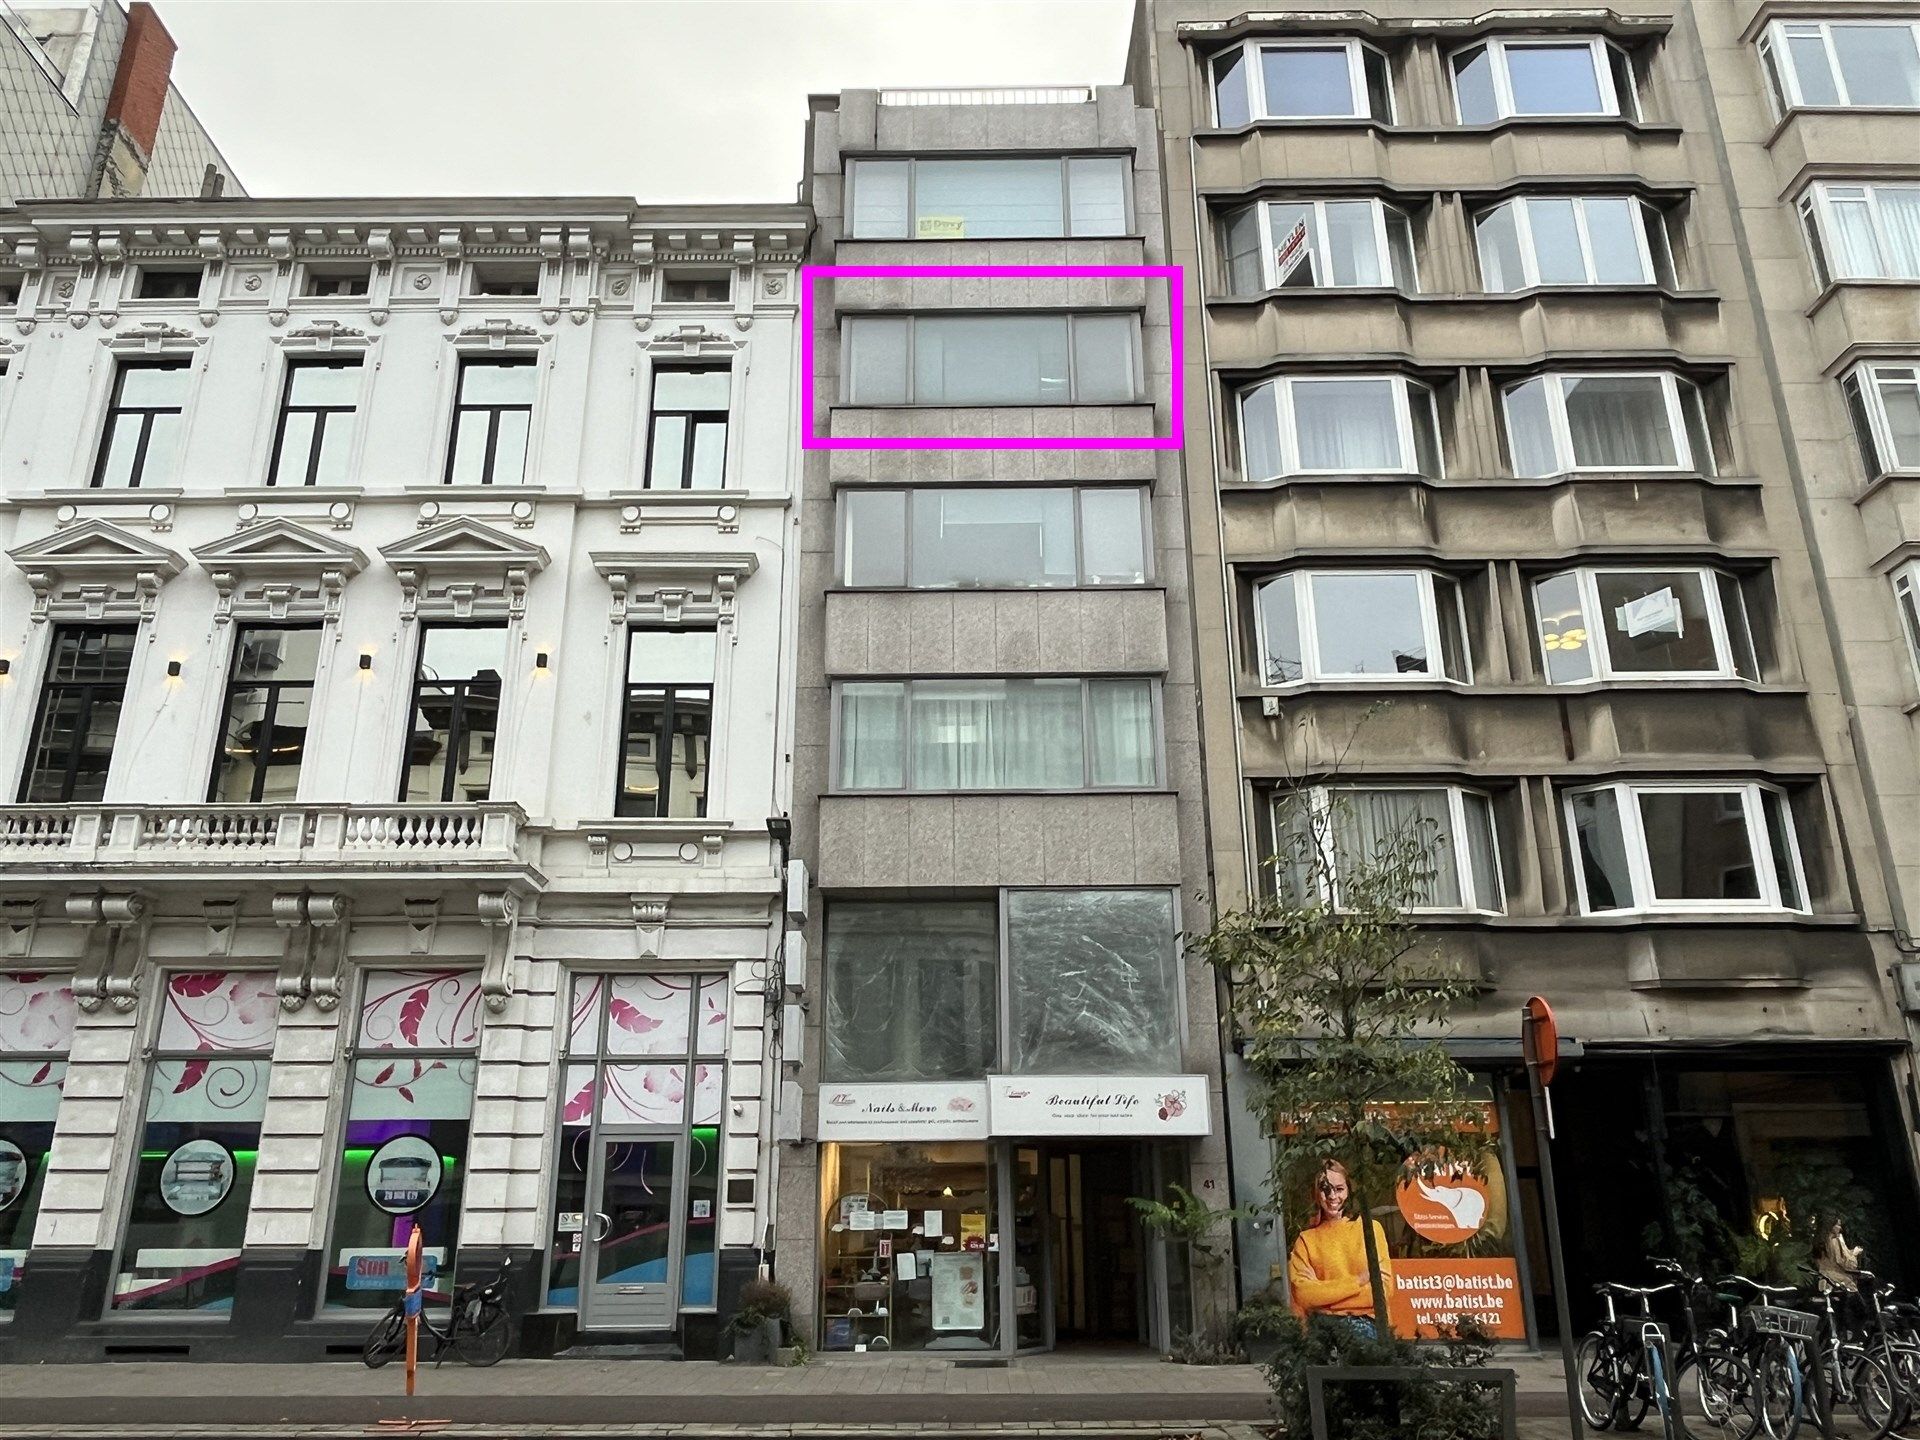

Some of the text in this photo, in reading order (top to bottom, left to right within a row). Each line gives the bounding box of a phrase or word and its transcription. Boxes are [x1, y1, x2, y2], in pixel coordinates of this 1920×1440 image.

[862, 1102, 896, 1113] Nails
[905, 1102, 938, 1112] More
[1045, 1094, 1111, 1110] Beautiful
[1115, 1094, 1139, 1110] Life
[1204, 1179, 1215, 1189] 41
[1396, 1273, 1513, 1292] batist3@batist.be
[1410, 1293, 1504, 1309] www.batist.be
[1416, 1312, 1434, 1324] tel.
